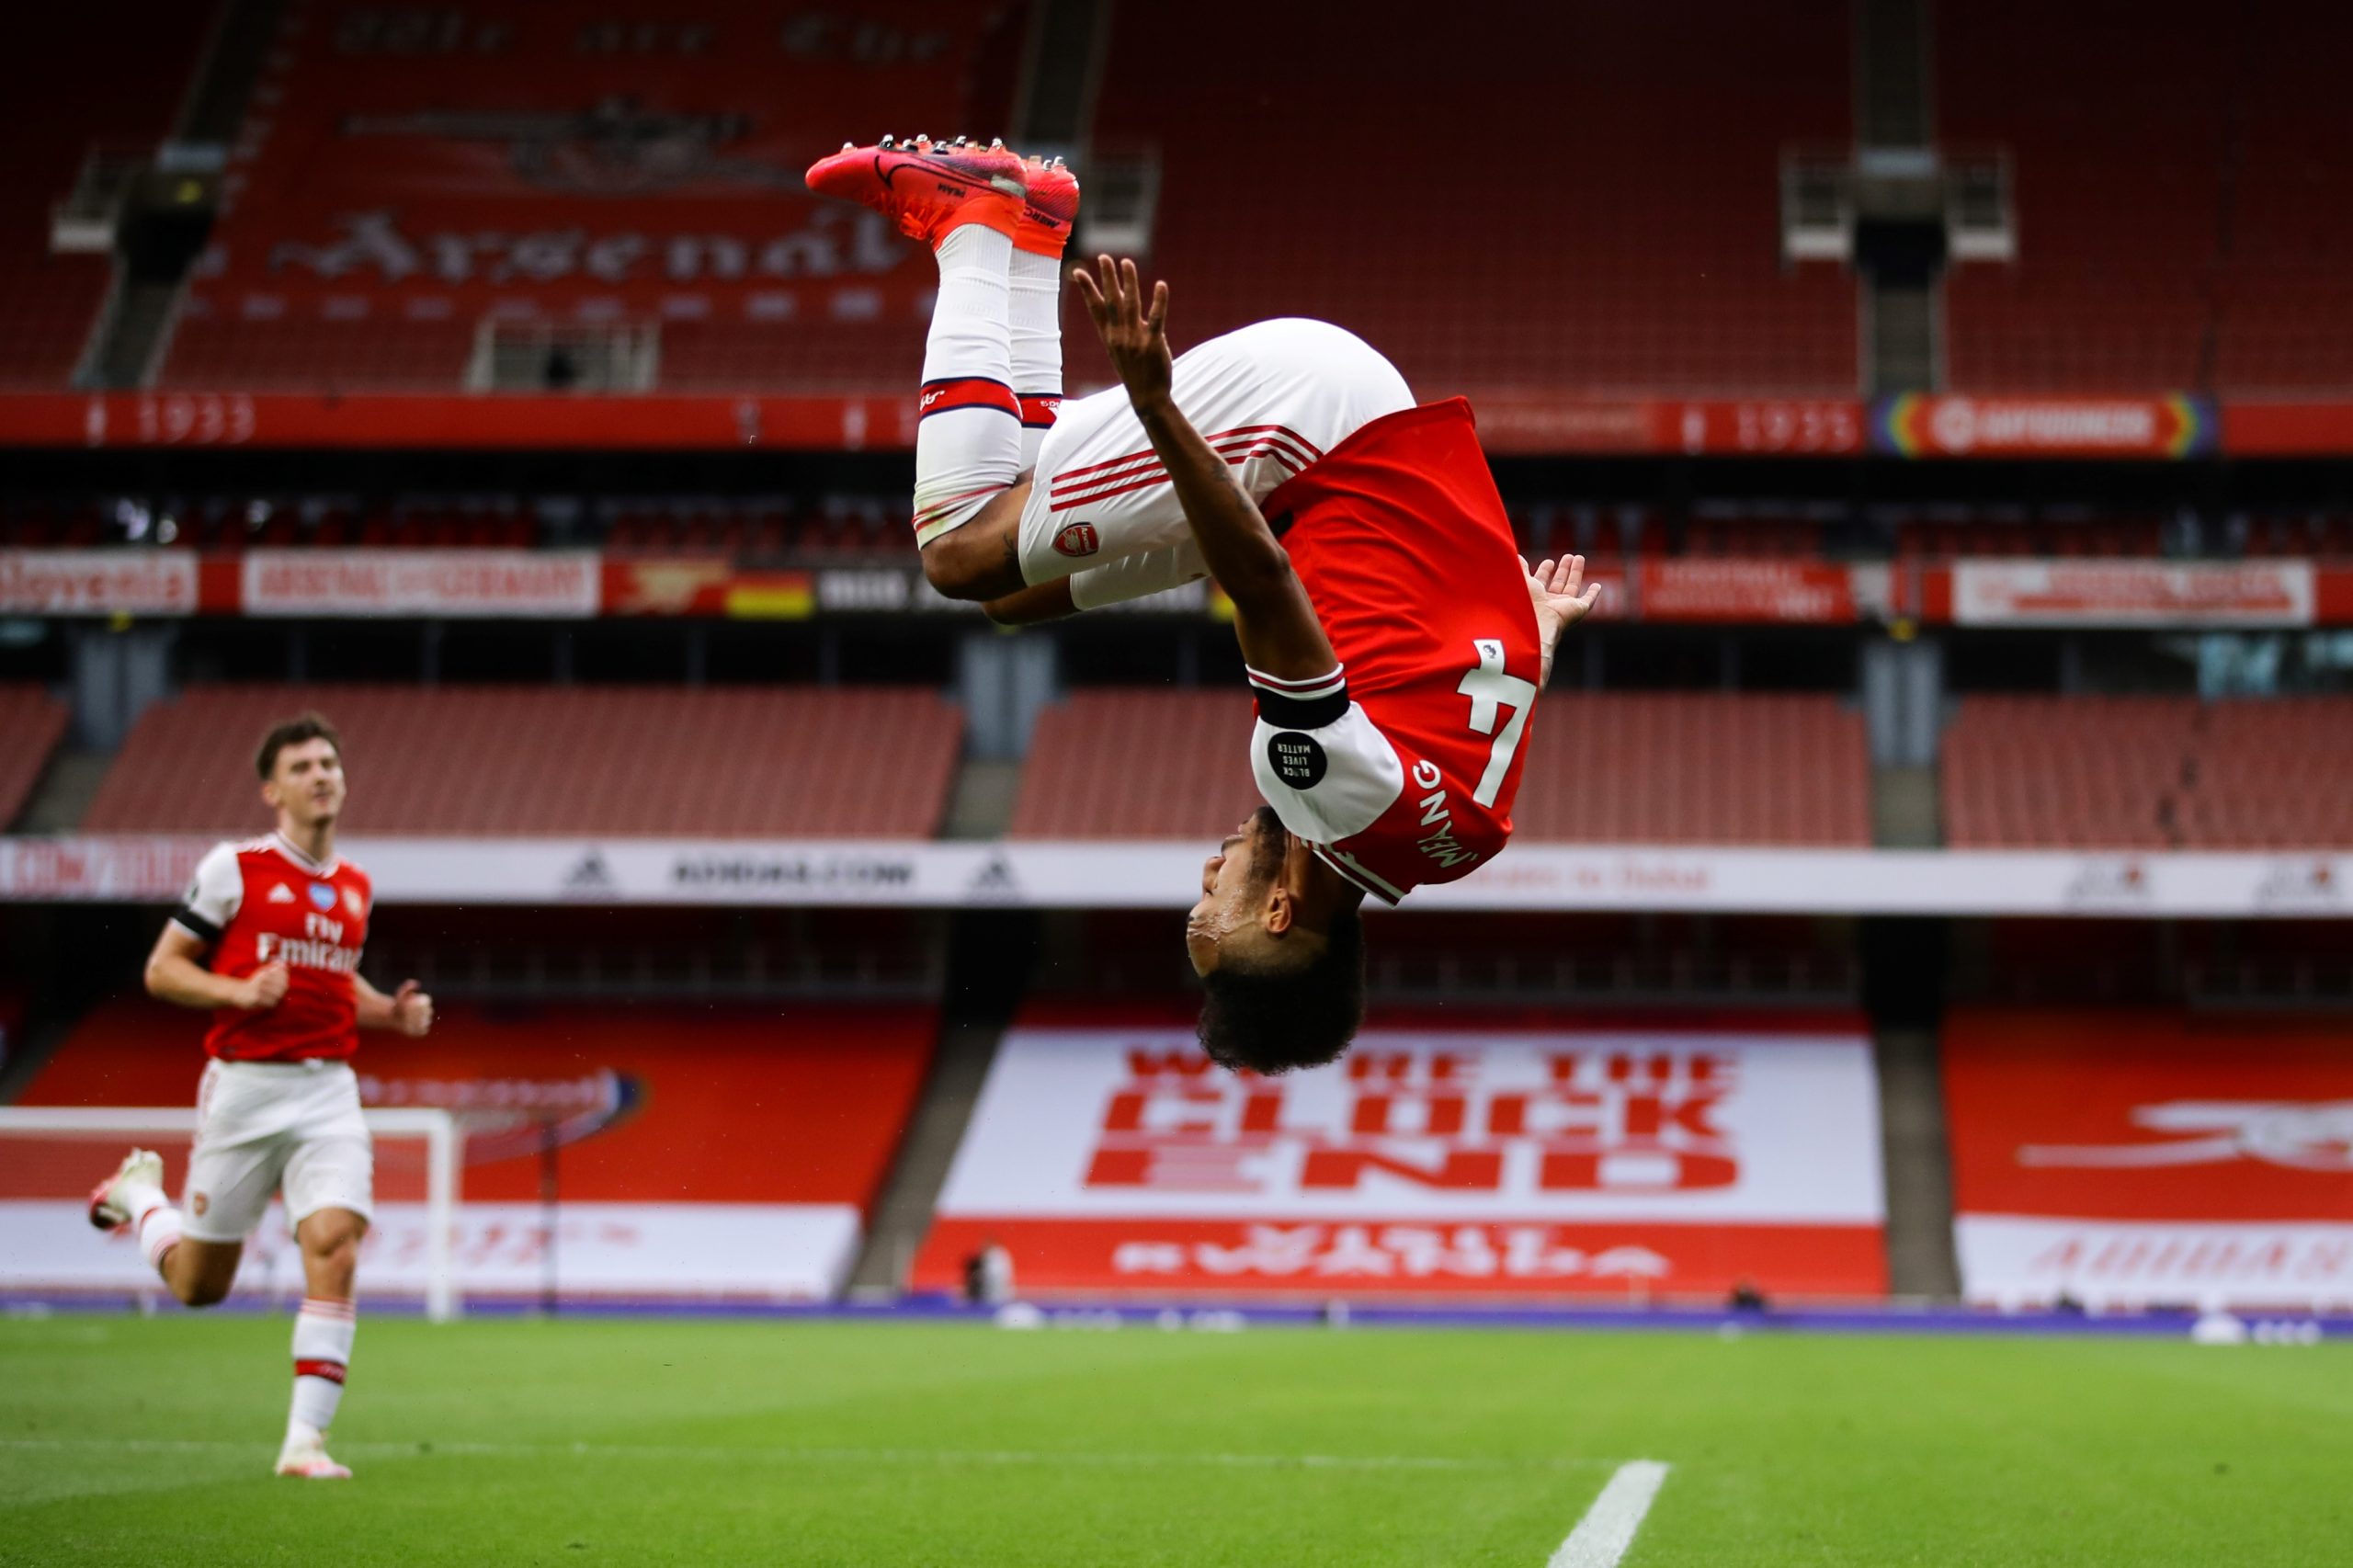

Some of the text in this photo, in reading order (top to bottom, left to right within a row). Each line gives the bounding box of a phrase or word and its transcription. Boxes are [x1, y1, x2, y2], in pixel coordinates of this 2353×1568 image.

[267, 211, 904, 283] Arsenal
[1457, 639, 1537, 809] 4
[1277, 743, 1311, 754] MATTER
[1282, 756, 1307, 765] LIVES
[1283, 767, 1310, 777] BLCK
[1412, 759, 1479, 868] MEANG
[305, 913, 344, 945] Fly
[256, 932, 364, 974] Emira
[1544, 1046, 1739, 1085] THE
[1103, 1090, 1728, 1142] CLOCK
[1083, 1145, 1737, 1193] END
